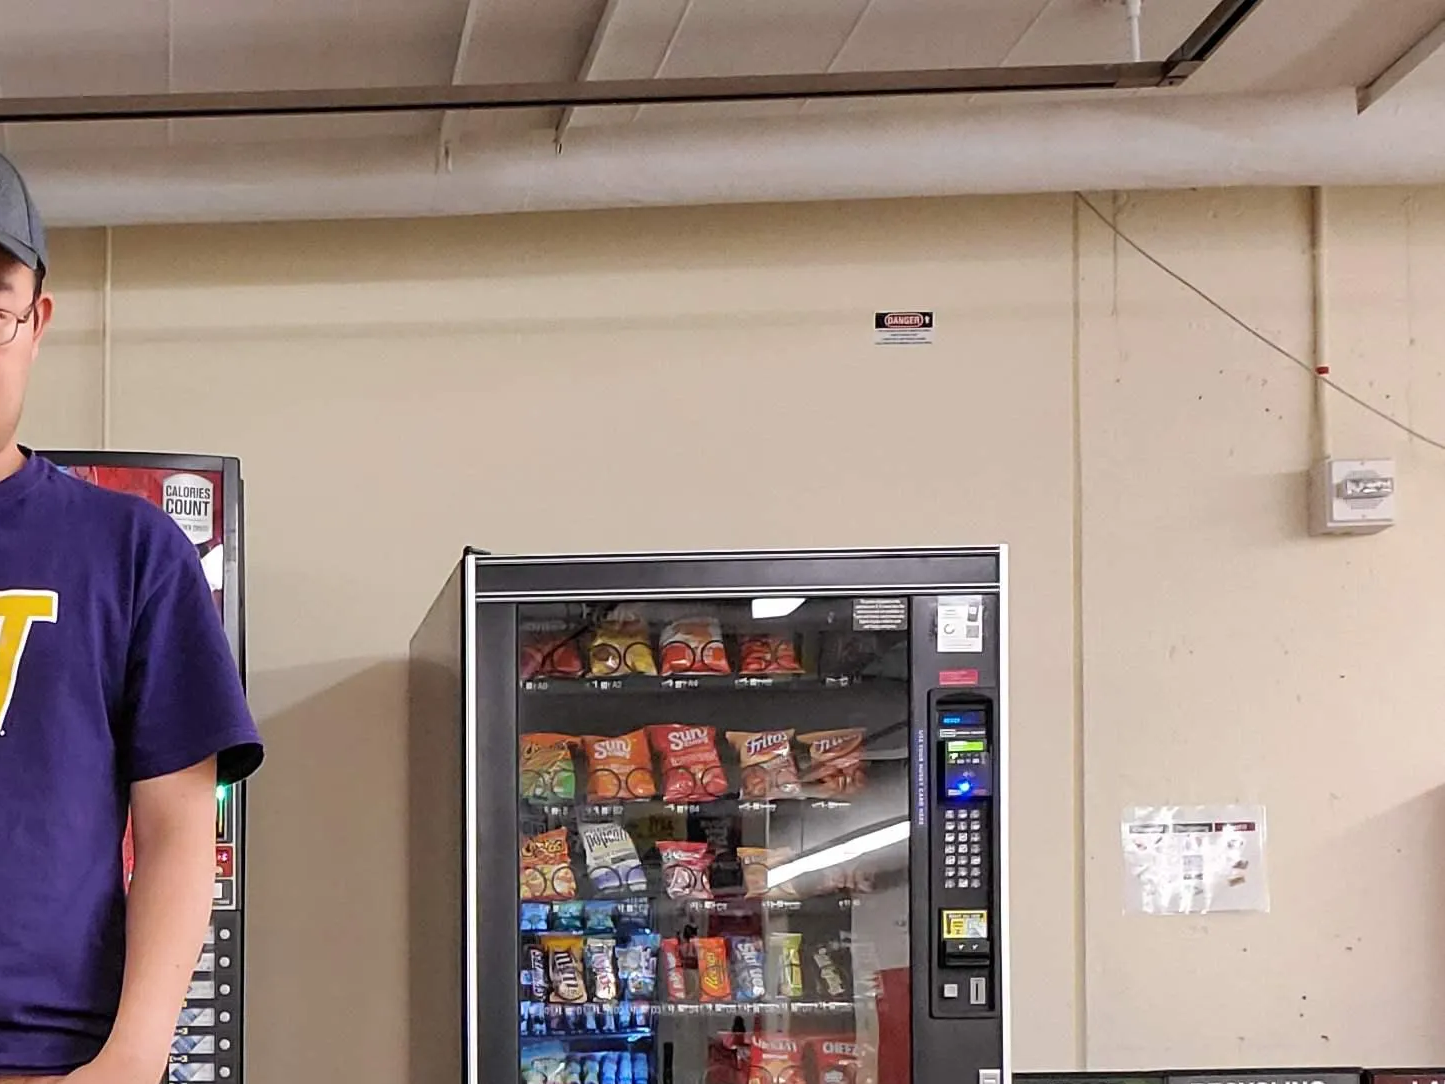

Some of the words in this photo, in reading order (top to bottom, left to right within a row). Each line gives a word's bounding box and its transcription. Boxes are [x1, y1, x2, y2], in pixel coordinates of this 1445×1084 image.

[887, 315, 920, 325] DANGER
[165, 485, 211, 500] CALORIES
[165, 499, 210, 516] COUNT
